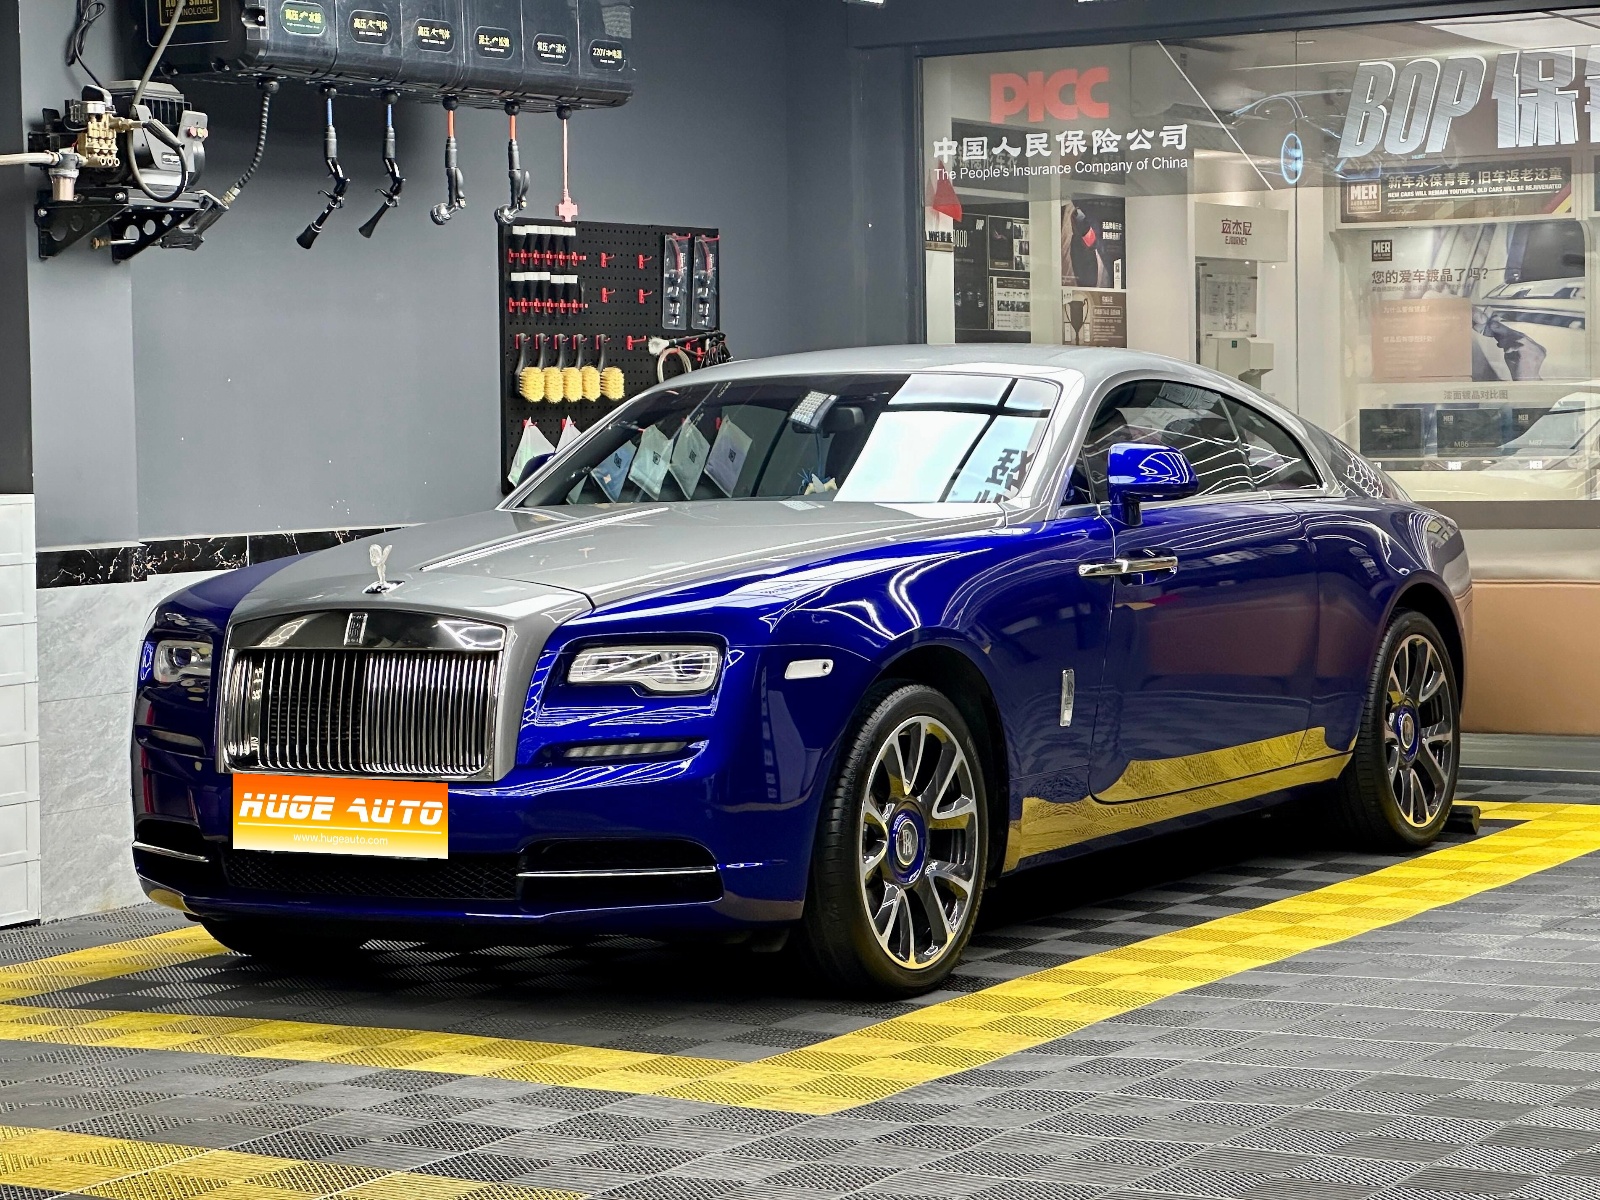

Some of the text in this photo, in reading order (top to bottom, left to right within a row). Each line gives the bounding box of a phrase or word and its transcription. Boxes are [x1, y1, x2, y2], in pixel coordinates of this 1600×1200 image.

[165, 6, 214, 18] TENOLOGIE
[989, 66, 1110, 124] PICC
[1337, 45, 1600, 159] BOP 保
[933, 124, 1189, 164] 中国人民保险公司
[934, 168, 956, 181] The
[960, 165, 1010, 181] People's
[1013, 162, 1071, 177] Insurance
[1075, 160, 1133, 175] Company
[1136, 157, 1148, 171] of
[1151, 156, 1189, 170] China
[1350, 185, 1377, 200] MER
[1387, 191, 1400, 199] NEW
[1428, 189, 1449, 197] REMAIN
[1488, 186, 1503, 194] CARS
[1525, 183, 1562, 191] REJUVENATED
[1373, 241, 1391, 253] MER
[1454, 440, 1469, 448] M86
